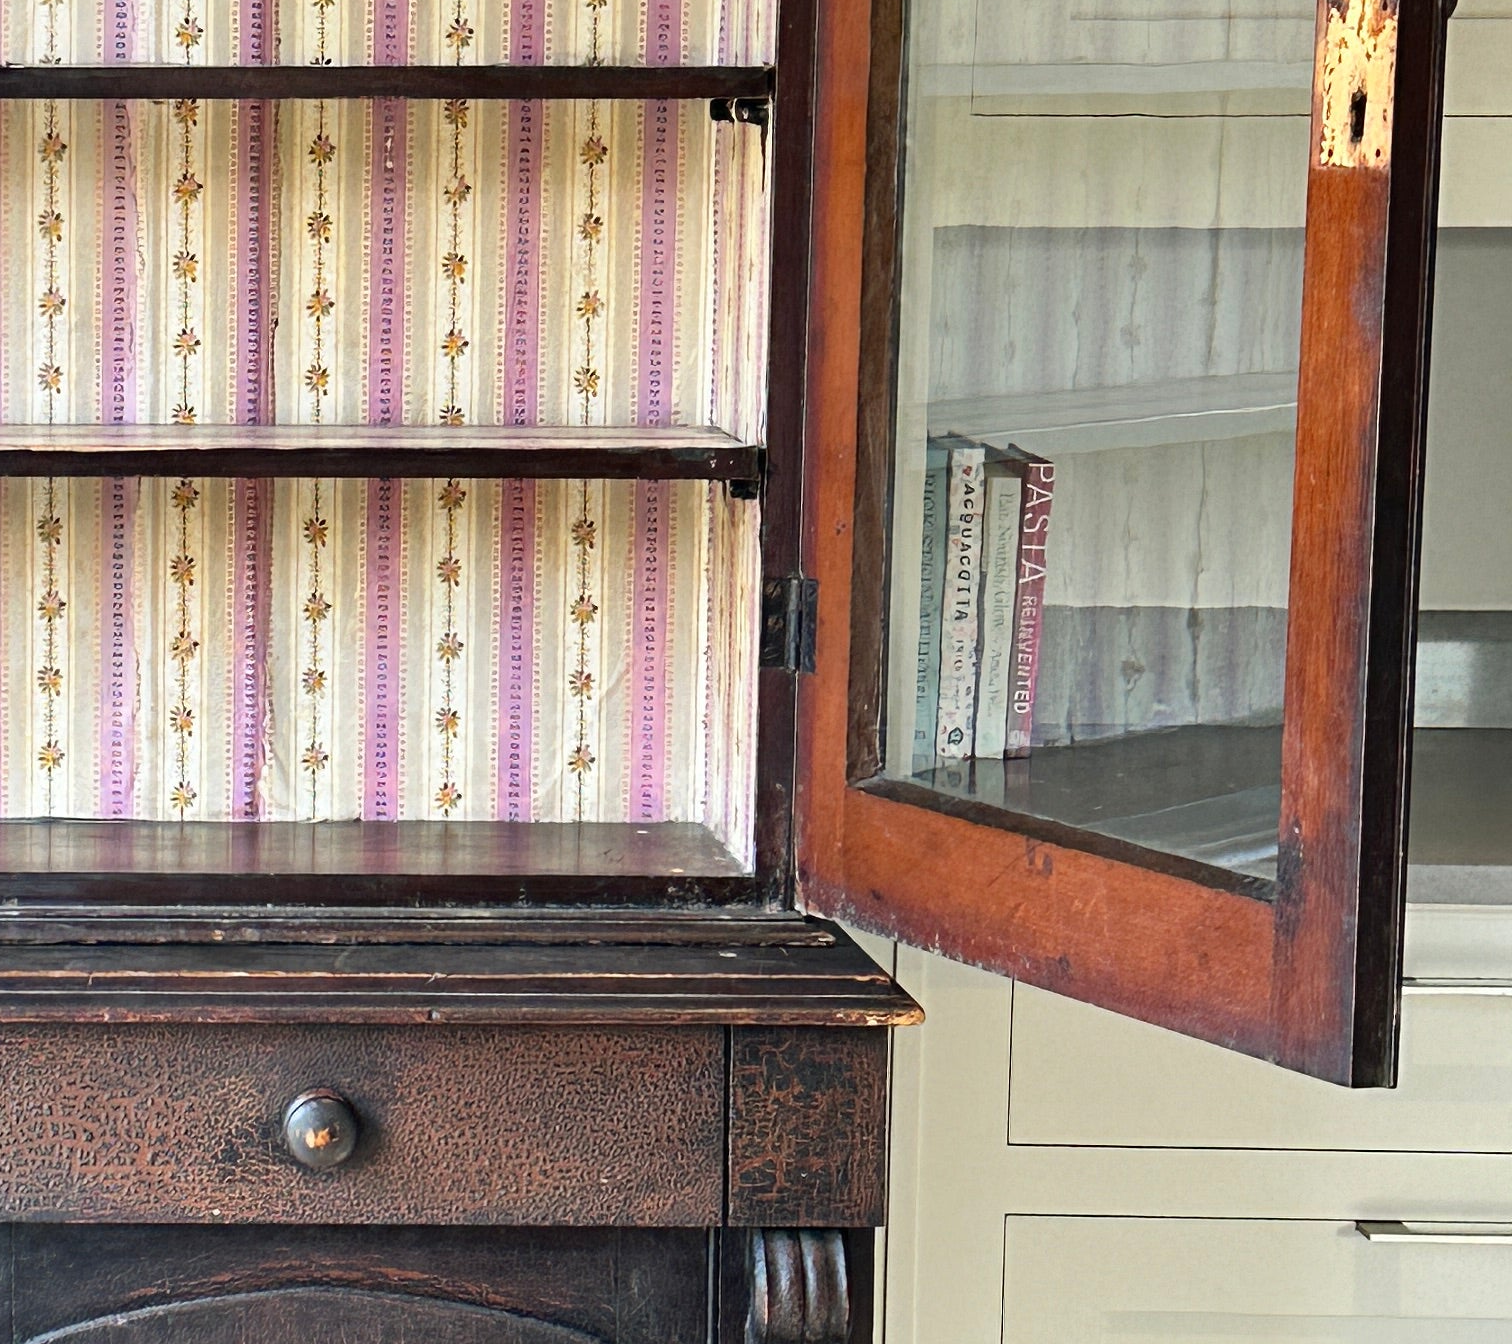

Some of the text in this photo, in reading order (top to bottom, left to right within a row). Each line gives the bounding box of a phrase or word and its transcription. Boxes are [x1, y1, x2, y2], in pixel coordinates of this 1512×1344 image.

[954, 484, 975, 621] ACQUACOTTA
[1019, 463, 1055, 583] PASTA
[1013, 595, 1037, 713] REINVENTED
